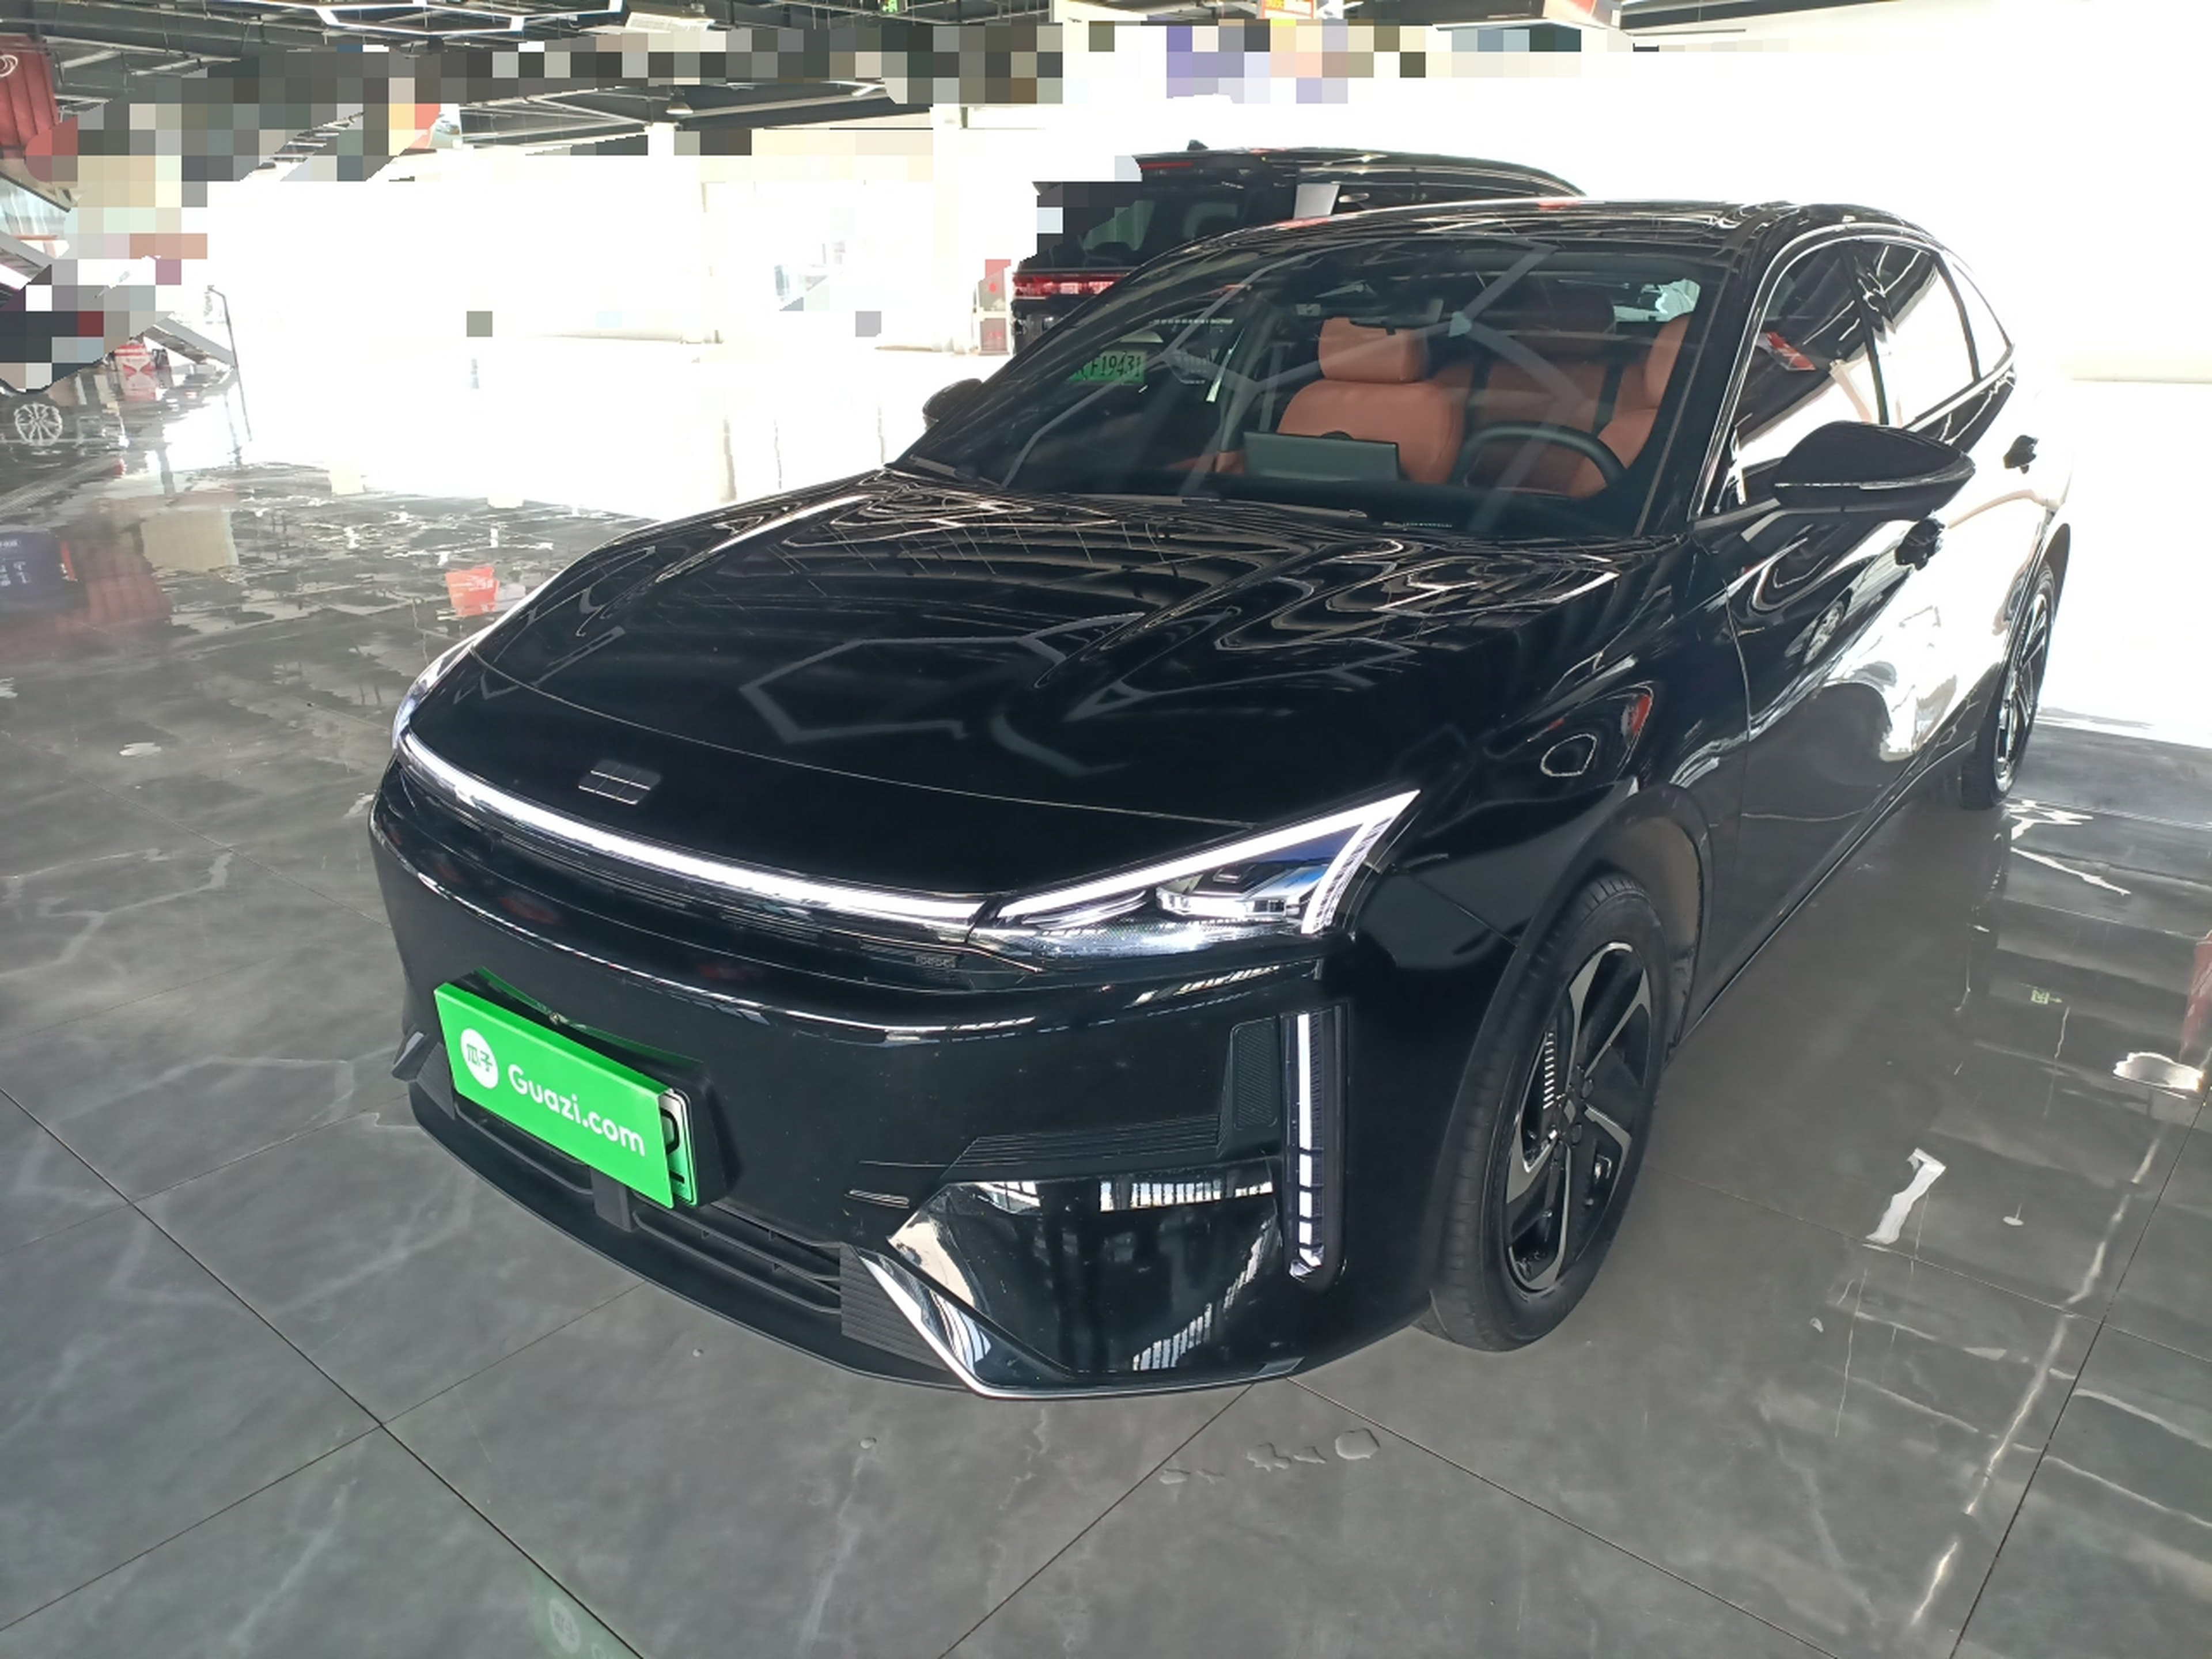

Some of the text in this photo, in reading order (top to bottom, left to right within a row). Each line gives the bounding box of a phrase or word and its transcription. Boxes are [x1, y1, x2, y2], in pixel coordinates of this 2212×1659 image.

[1078, 355, 1141, 380] F19431
[466, 1043, 493, 1072] 瓜子
[507, 1063, 646, 1157] Guazi.com
